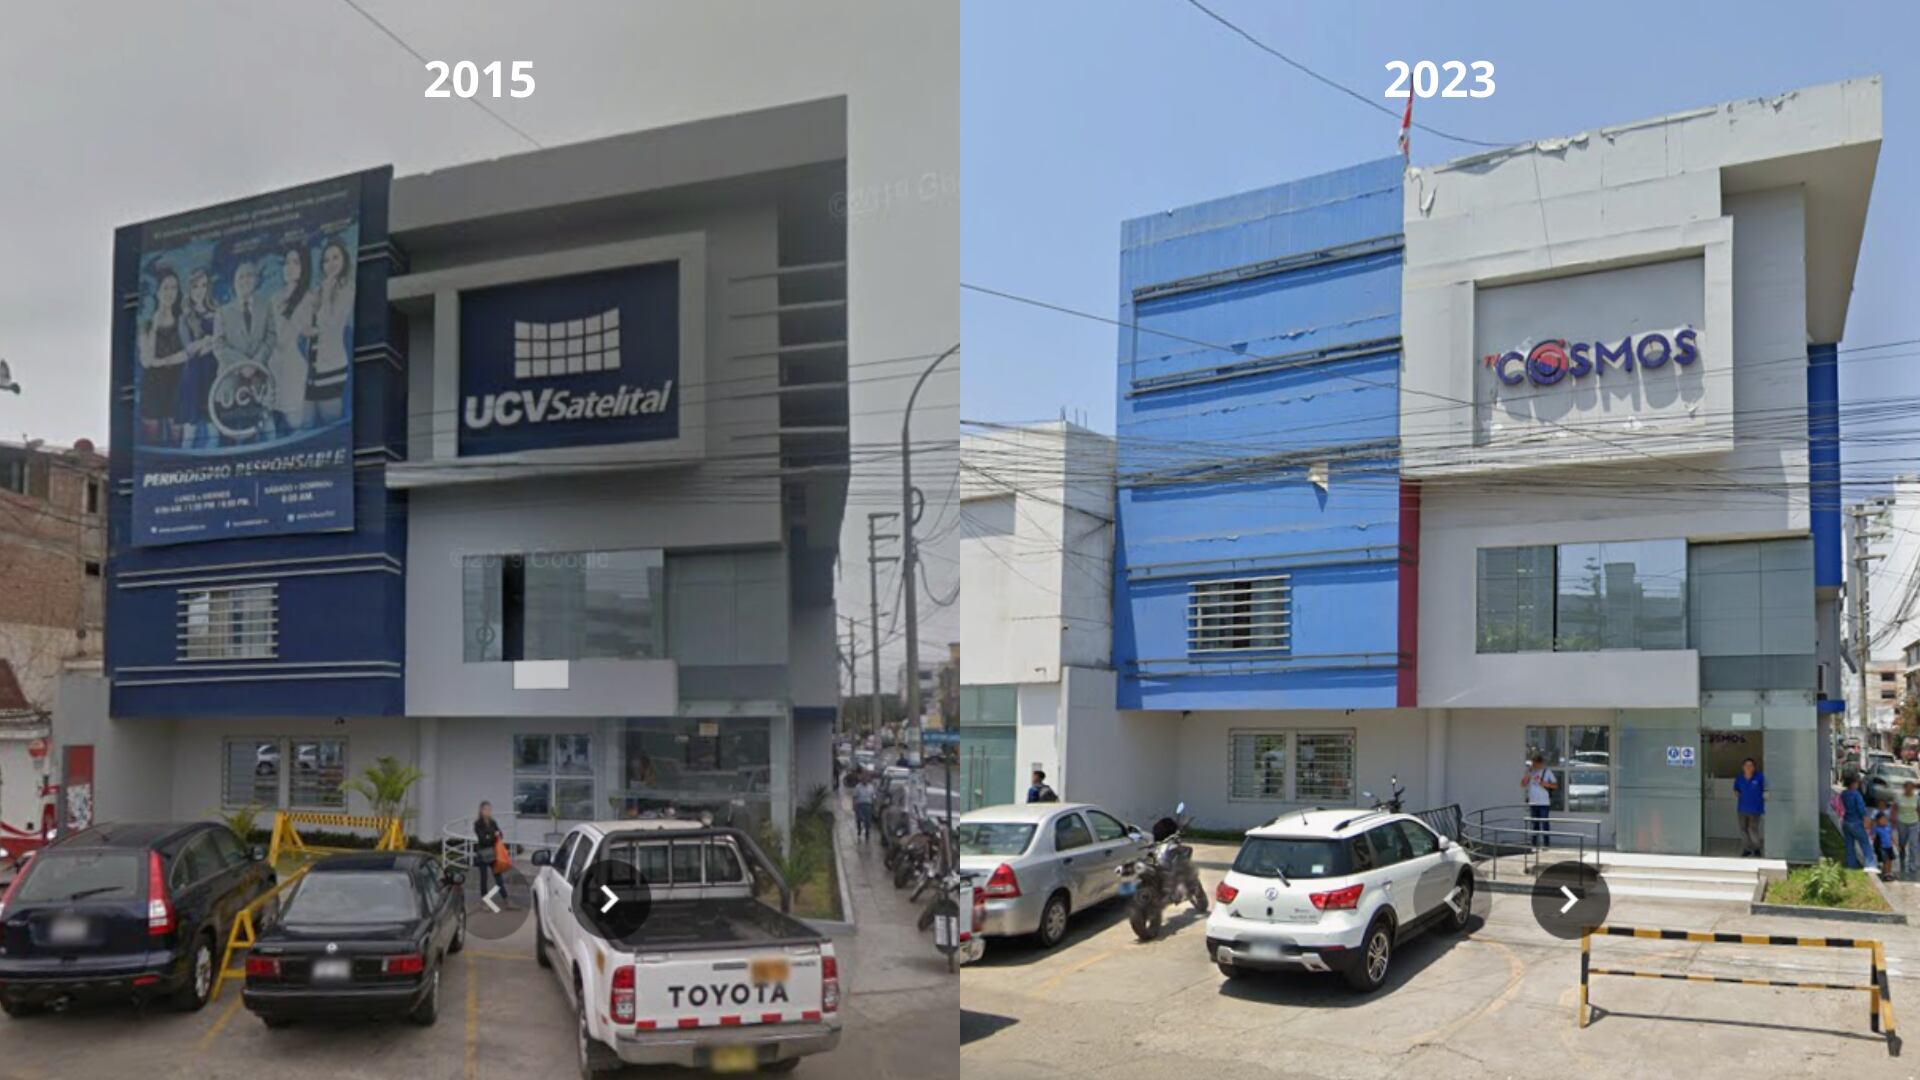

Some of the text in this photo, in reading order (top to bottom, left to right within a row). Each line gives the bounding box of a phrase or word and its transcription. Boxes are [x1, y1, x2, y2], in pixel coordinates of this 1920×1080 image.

[1497, 328, 1697, 386] COSMOS
[143, 449, 346, 488] PERIODISMO RESPONSABLE
[667, 983, 789, 1008] TOYOTA
